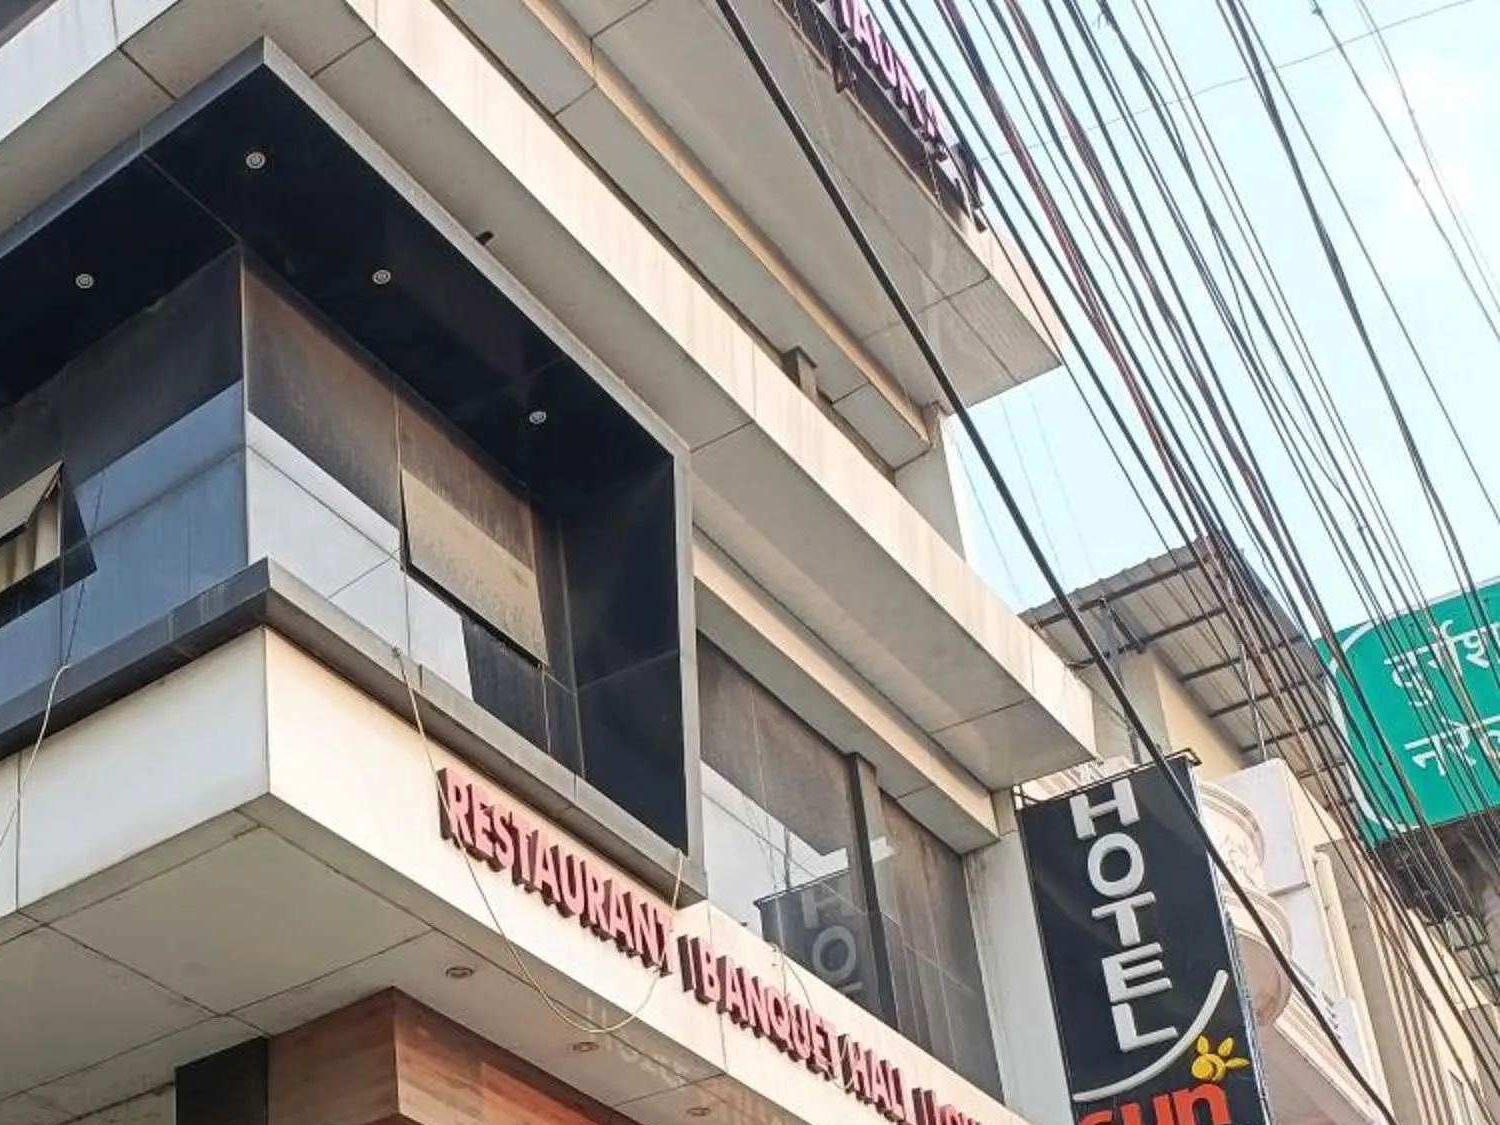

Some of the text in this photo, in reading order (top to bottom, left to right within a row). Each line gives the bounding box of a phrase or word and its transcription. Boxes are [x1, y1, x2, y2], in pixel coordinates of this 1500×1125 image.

[440, 768, 675, 977] RESTAURANT
[699, 937, 844, 1088] BANQUET
[1070, 776, 1179, 1053] HOTEL
